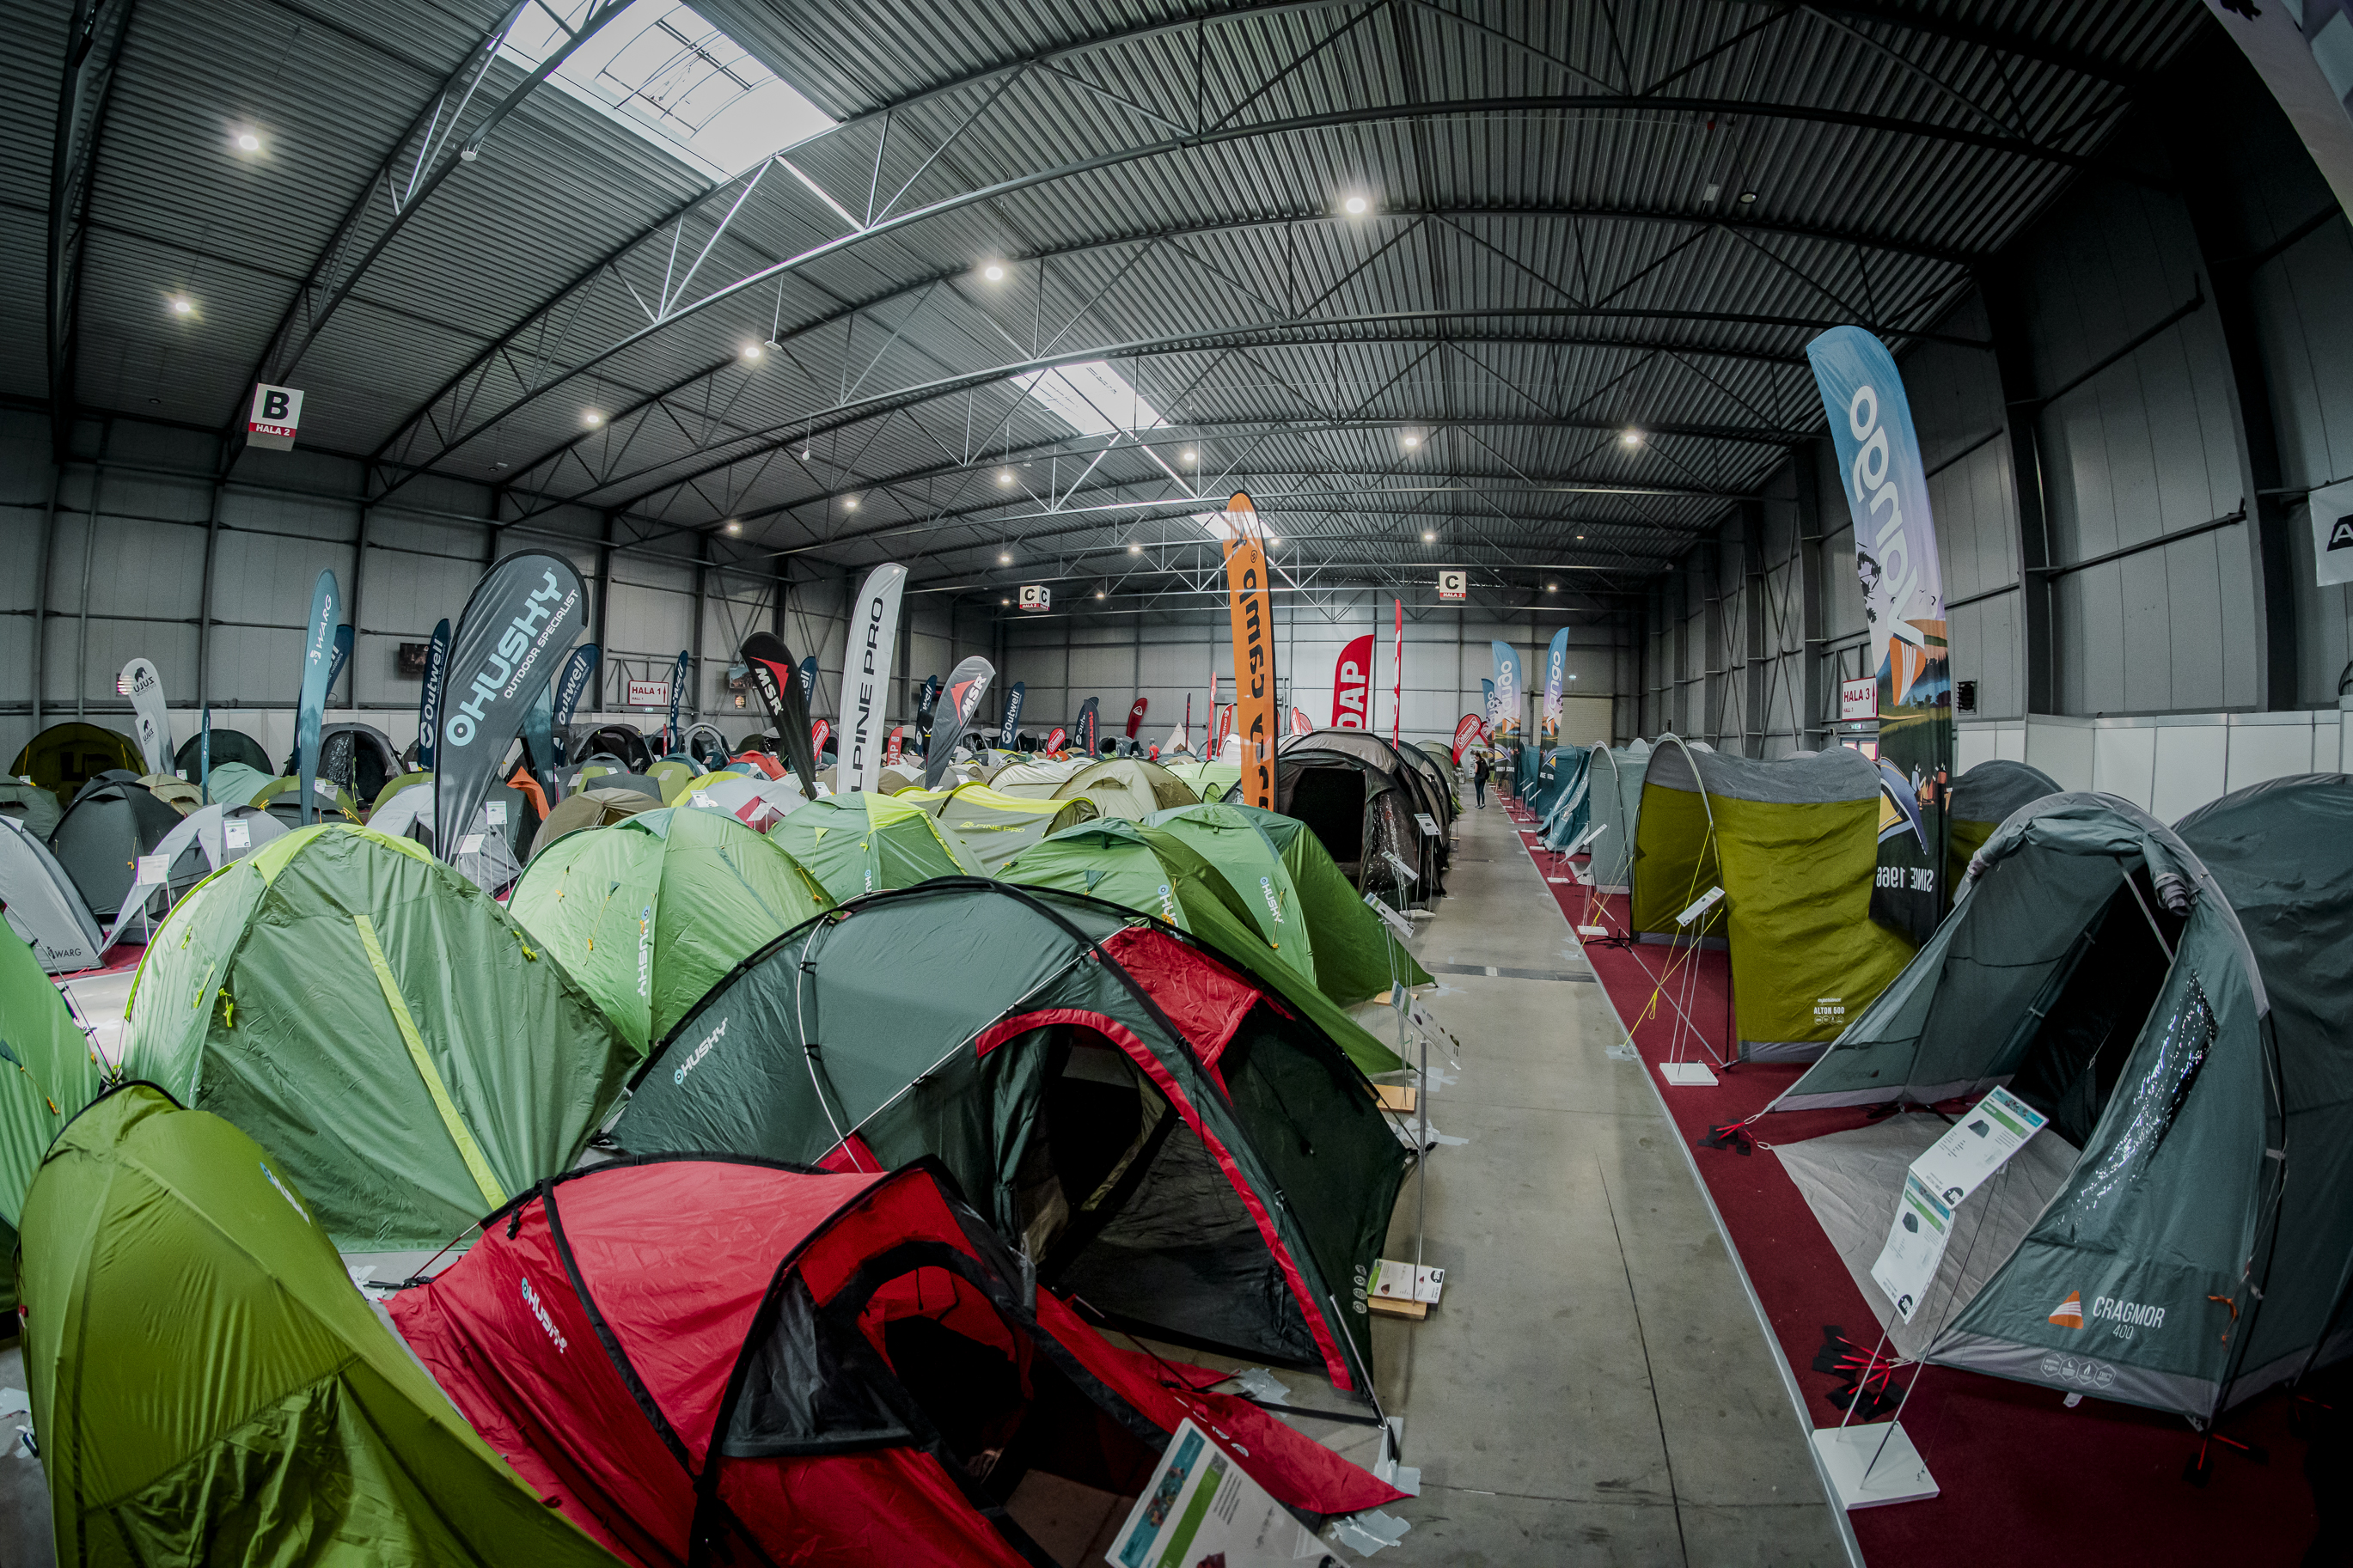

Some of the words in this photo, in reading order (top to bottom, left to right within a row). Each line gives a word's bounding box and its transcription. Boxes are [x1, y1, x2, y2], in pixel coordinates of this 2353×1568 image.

[261, 389, 290, 421] B
[255, 424, 282, 436] HALA
[283, 428, 290, 436] 2
[1024, 588, 1036, 601] C
[1041, 589, 1048, 603] C
[1445, 575, 1459, 590] C
[315, 594, 332, 650] WARG
[459, 570, 563, 722] HUSKY
[504, 647, 541, 699] OUTDOOR
[537, 589, 578, 648] SPECIALIST
[424, 638, 443, 720] Outwell
[559, 655, 587, 725] Outwell
[632, 686, 655, 695] HALA
[755, 668, 783, 716] MSR
[850, 682, 872, 792] LPINE
[863, 596, 883, 675] PRO
[962, 676, 987, 717] MSR
[1336, 661, 1366, 729] OAP
[1843, 689, 1864, 703] HALA
[1865, 687, 1870, 700] 3
[1005, 690, 1020, 731] Outwell
[889, 744, 899, 766] OAP
[1262, 883, 1283, 924] HUSKY
[54, 948, 82, 958] WARG
[1813, 1006, 1832, 1015] ALTON
[1833, 1006, 1845, 1015] 500
[681, 1021, 727, 1077] HUSKY
[2092, 1296, 2165, 1328] CRAGMOR
[2112, 1323, 2134, 1339] 400
